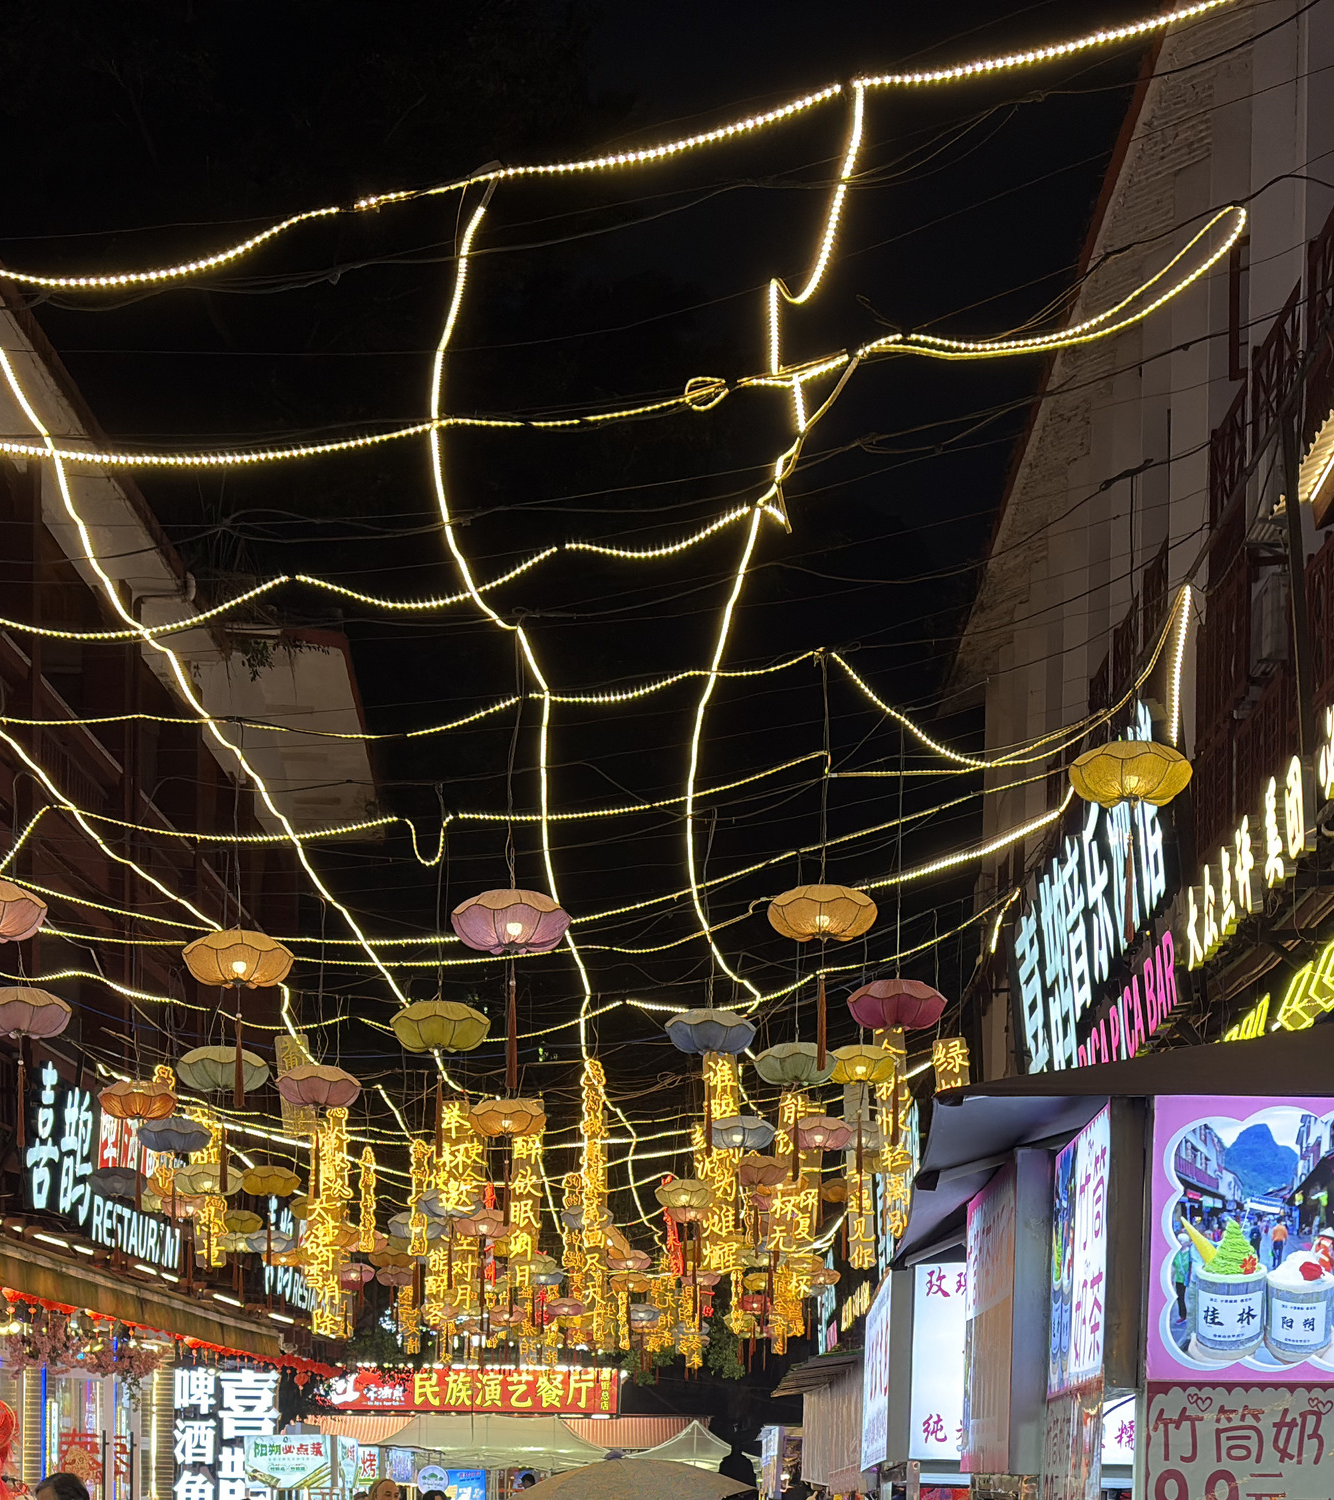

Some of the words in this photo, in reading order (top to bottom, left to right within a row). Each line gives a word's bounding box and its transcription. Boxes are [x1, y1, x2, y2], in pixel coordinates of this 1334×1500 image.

[1142, 930, 1177, 1037] BAR
[27, 1060, 92, 1226] 喜鹊
[1202, 1305, 1258, 1327] 桂林
[1280, 1315, 1316, 1332] 阳朔
[413, 1369, 596, 1410] 民族演艺餐厅
[360, 1450, 377, 1478] 烤
